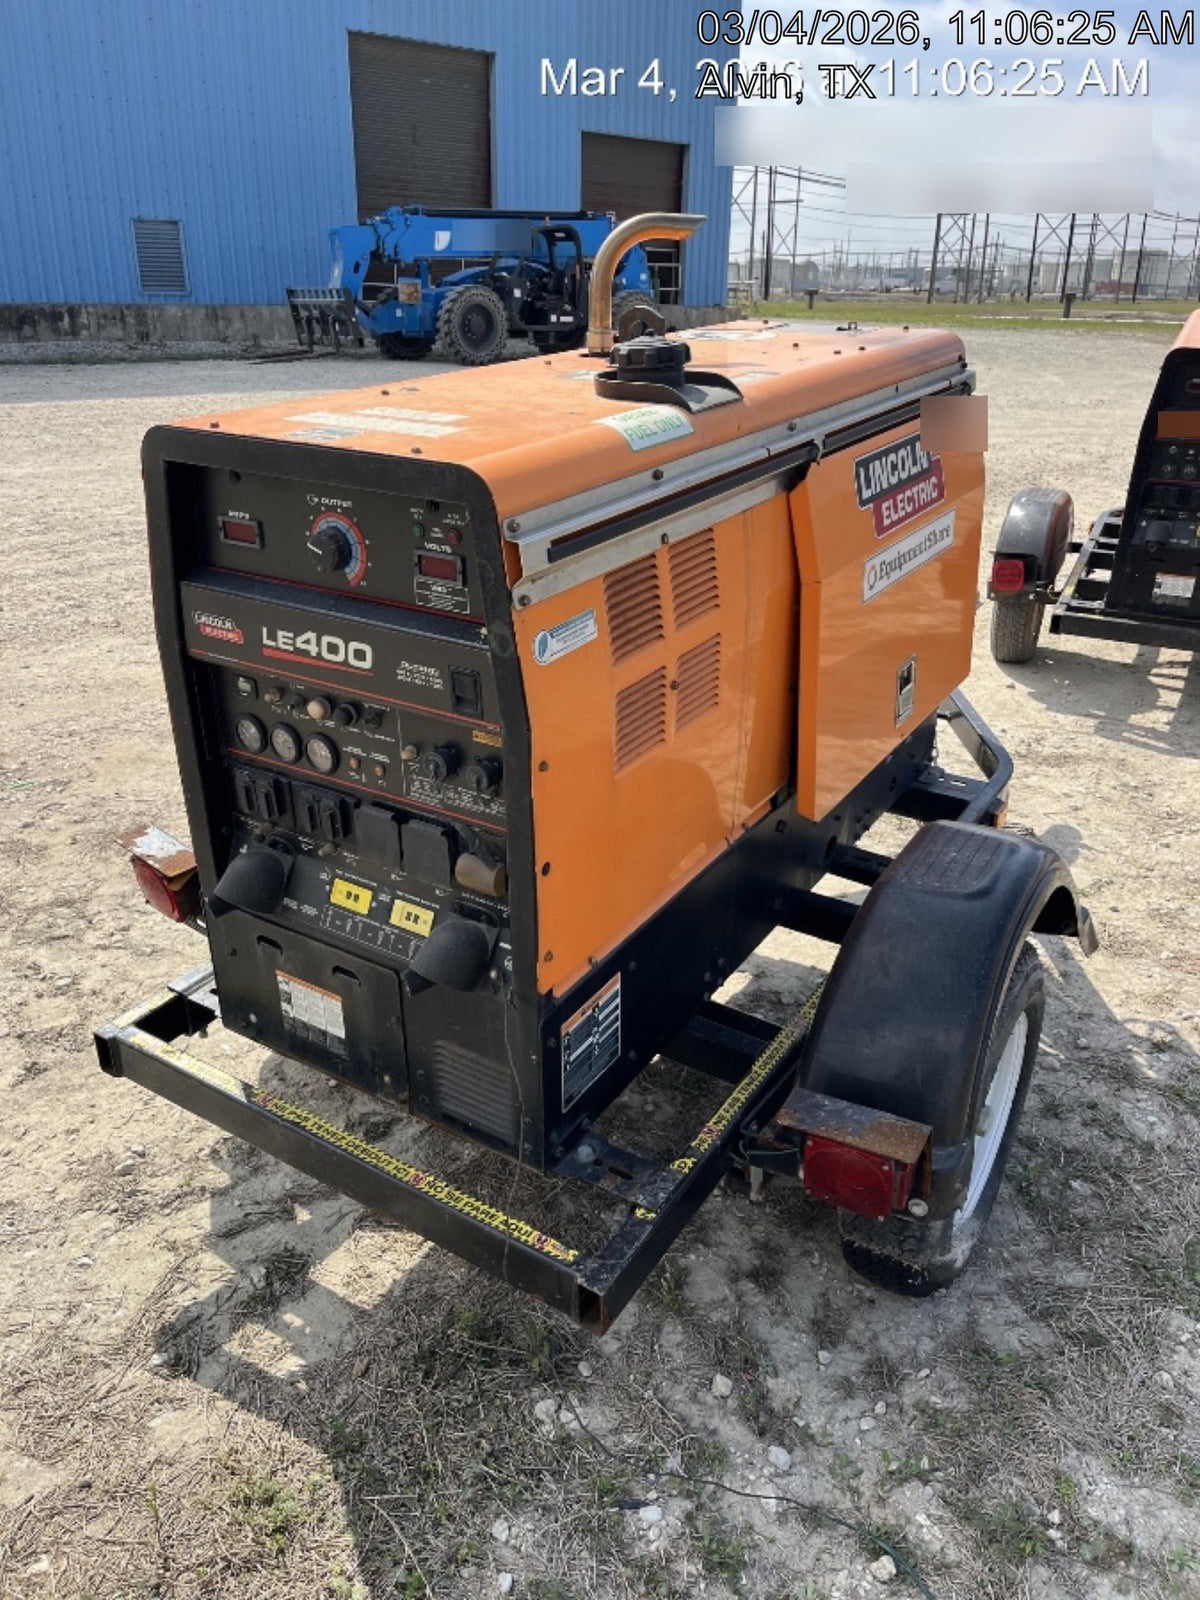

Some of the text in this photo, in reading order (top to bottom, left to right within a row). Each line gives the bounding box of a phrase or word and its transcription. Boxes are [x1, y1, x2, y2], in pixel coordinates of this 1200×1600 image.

[859, 441, 928, 501] LINCOLN
[880, 476, 938, 527] ELECTRIC
[424, 541, 453, 554] VOLTS
[262, 626, 373, 669] LE400
[425, 1180, 445, 1194] NO
[462, 1201, 499, 1222] PARE
